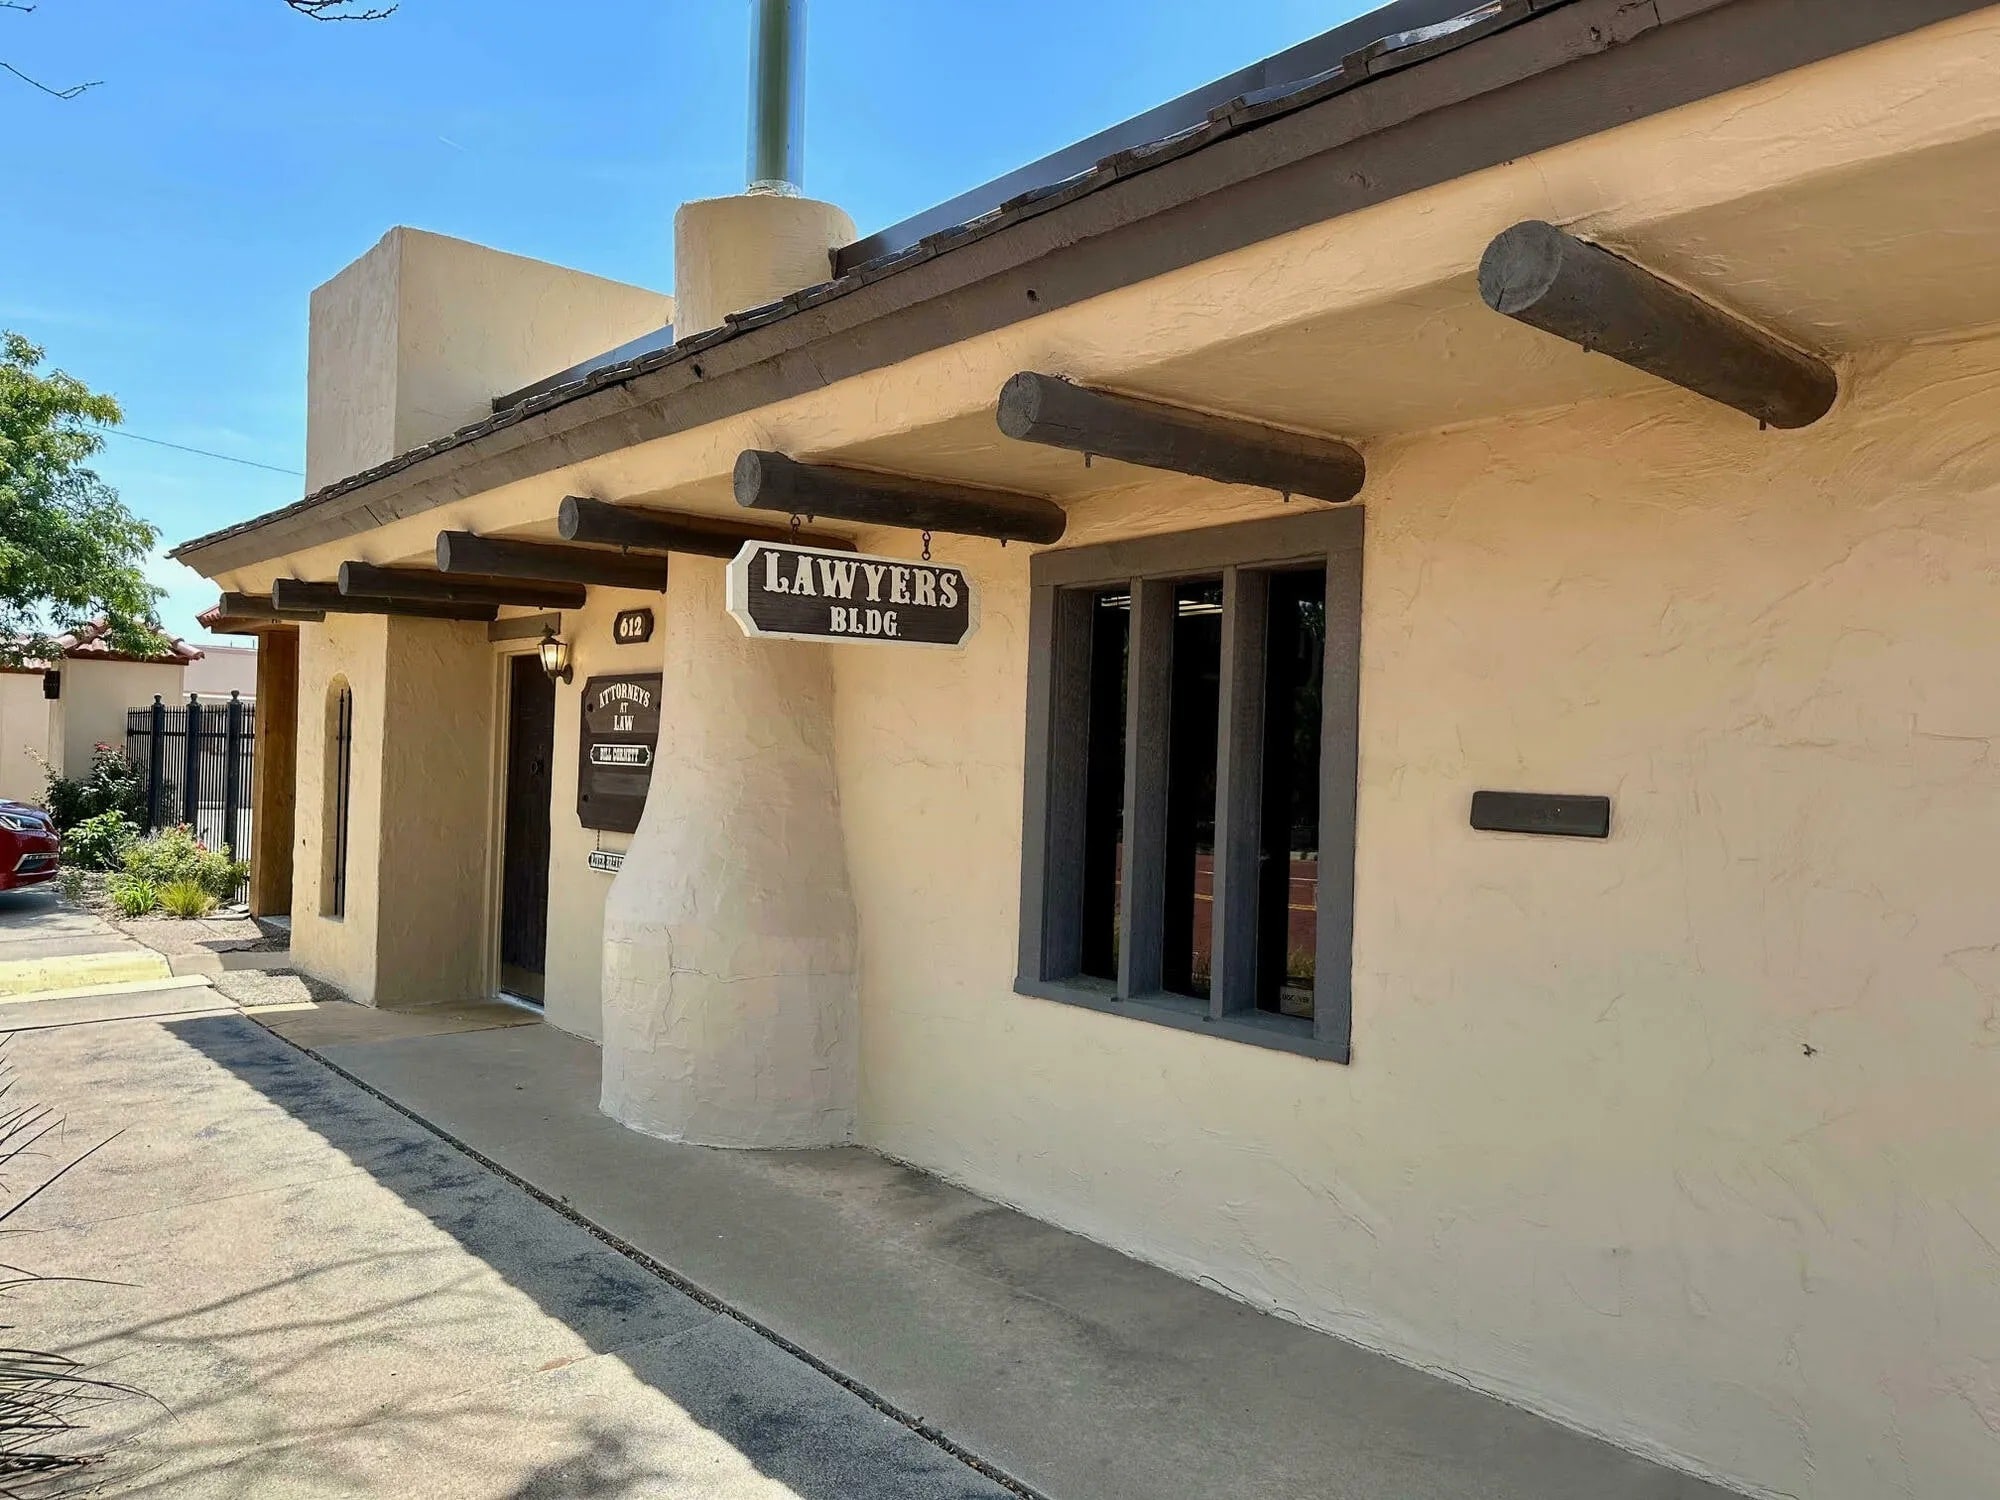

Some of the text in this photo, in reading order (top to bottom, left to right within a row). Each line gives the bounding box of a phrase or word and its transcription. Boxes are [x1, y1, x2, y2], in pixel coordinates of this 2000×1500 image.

[763, 551, 959, 608] LAWYER'S
[620, 616, 642, 637] 612
[830, 606, 901, 637] BLDG.
[599, 682, 651, 708] ATTORNEYS
[620, 702, 628, 713] AT
[613, 715, 634, 731] LAW
